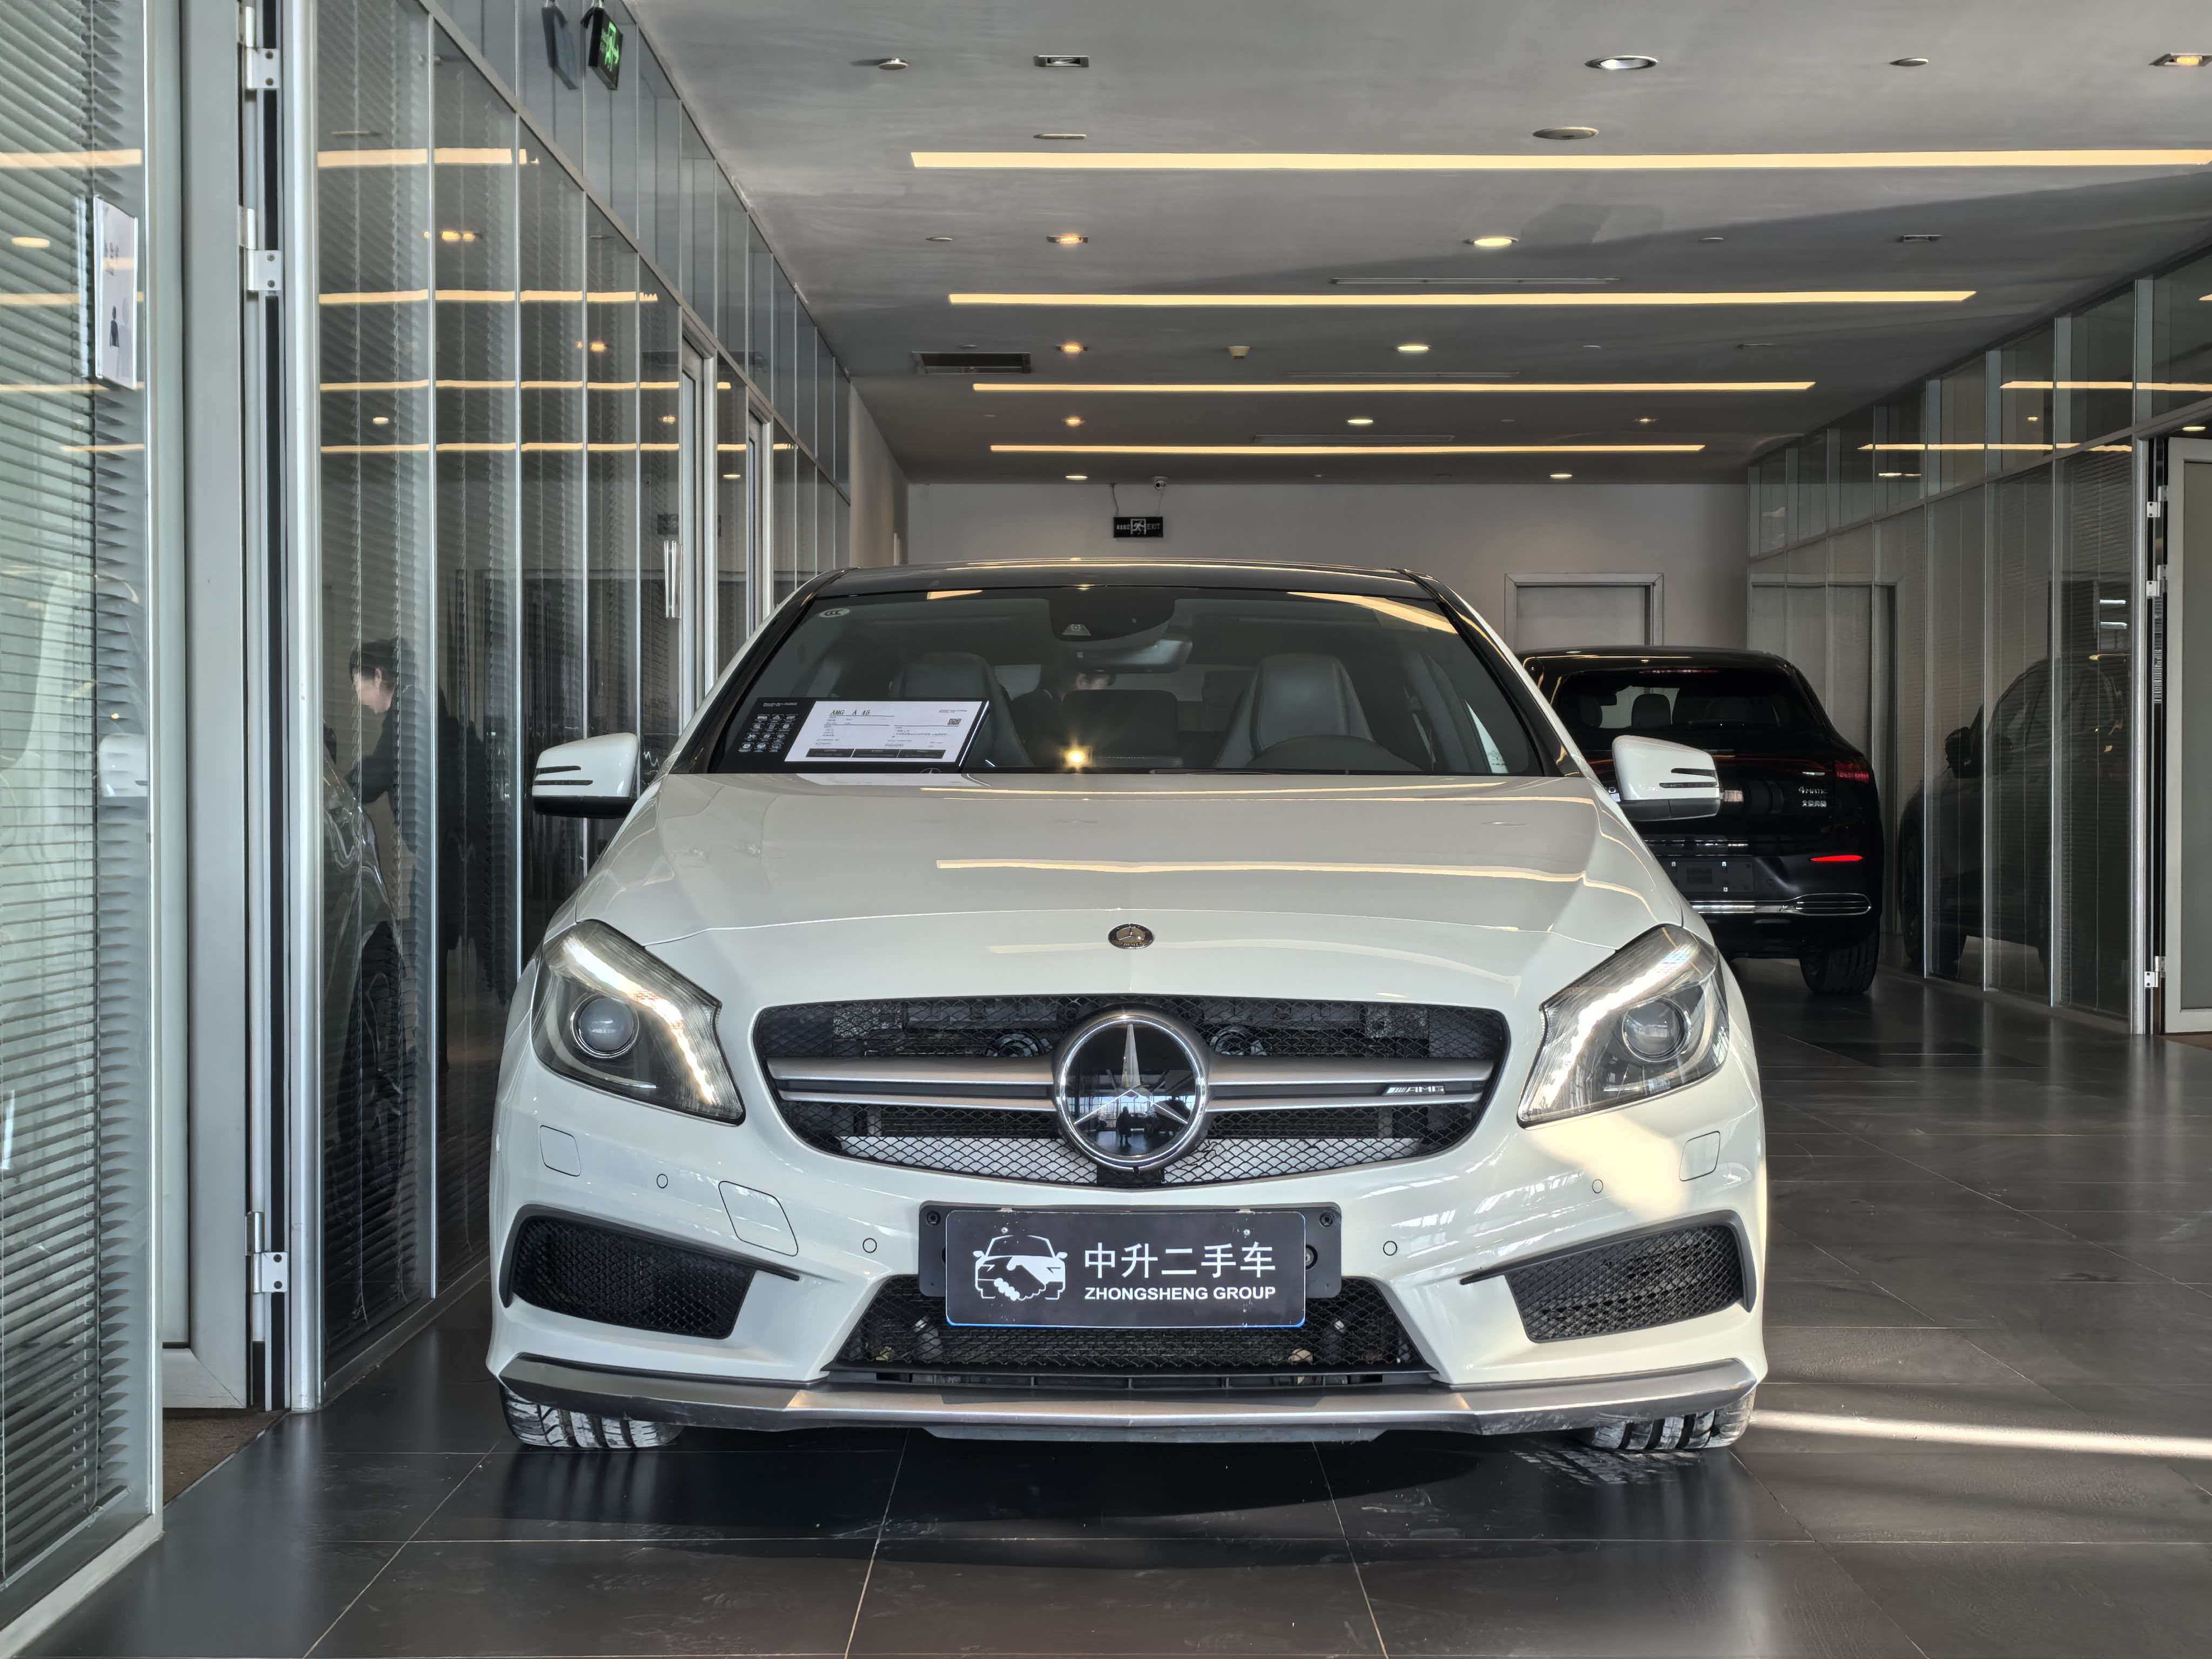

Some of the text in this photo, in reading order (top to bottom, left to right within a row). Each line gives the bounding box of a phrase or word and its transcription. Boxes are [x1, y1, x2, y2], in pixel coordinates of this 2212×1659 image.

[1406, 1085, 1445, 1094] AMG
[1084, 1242, 1277, 1279] 中升二手车
[1084, 1286, 1277, 1301] ZHONGSHENG GROUP
